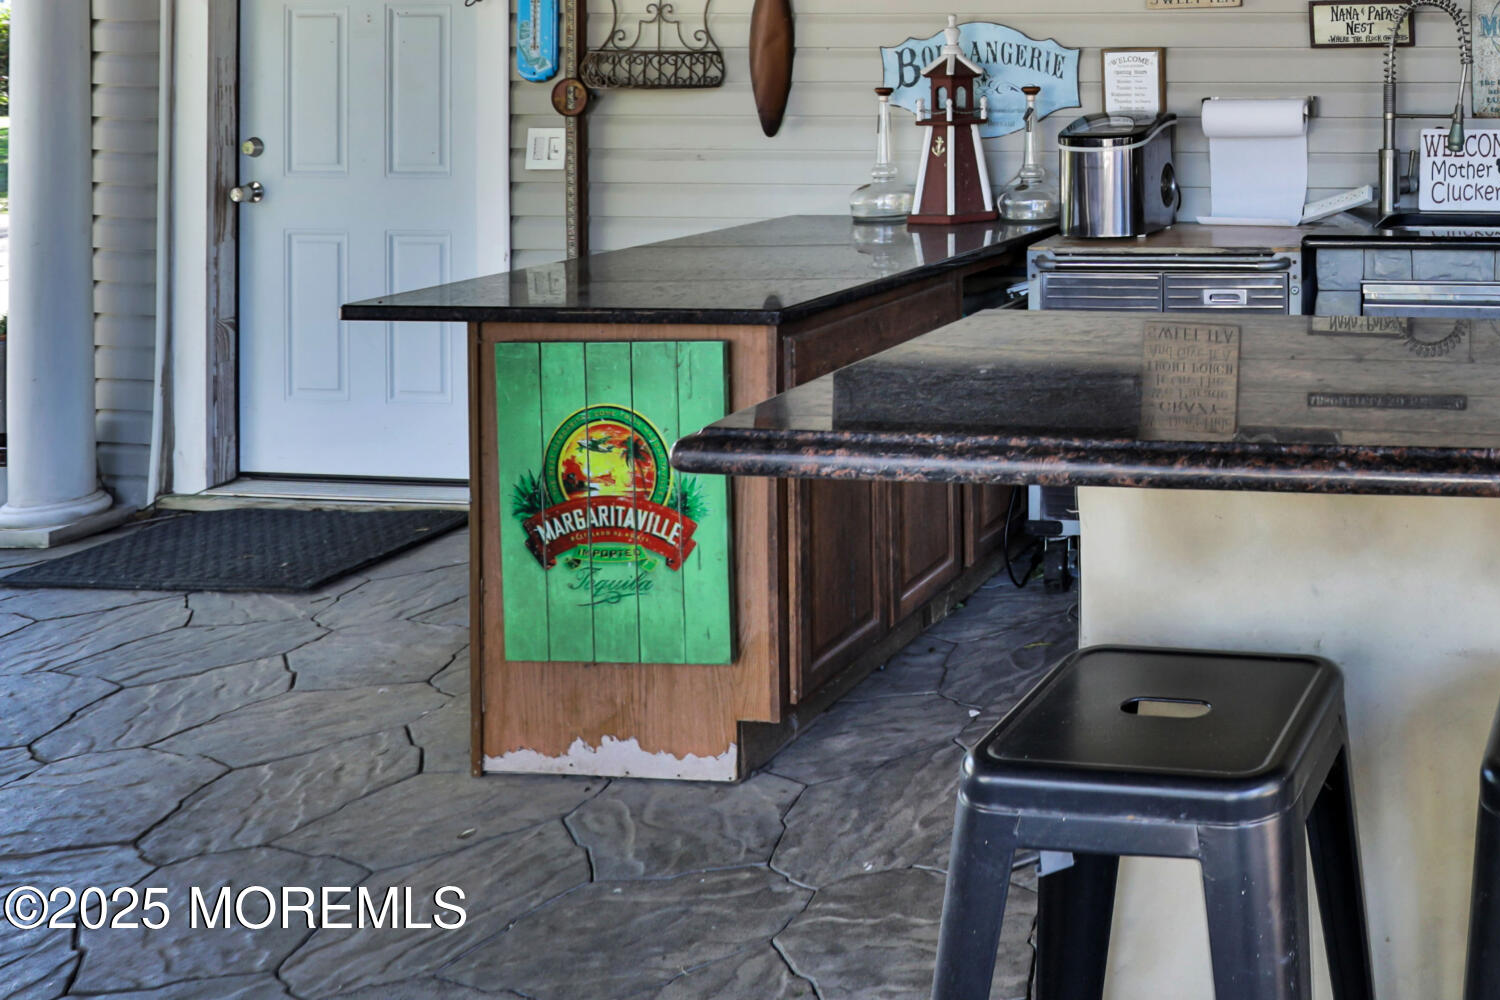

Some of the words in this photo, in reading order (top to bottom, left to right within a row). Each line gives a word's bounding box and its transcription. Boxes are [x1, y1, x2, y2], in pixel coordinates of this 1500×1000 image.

[1331, 5, 1359, 22] NANA
[1346, 22, 1375, 35] NEST
[895, 40, 1066, 89] BOANGERIE
[1431, 159, 1492, 181] Mother
[534, 505, 684, 546] MARGARITAVILLE
[577, 549, 641, 558] IMPORTED
[568, 566, 654, 597] Tequila
